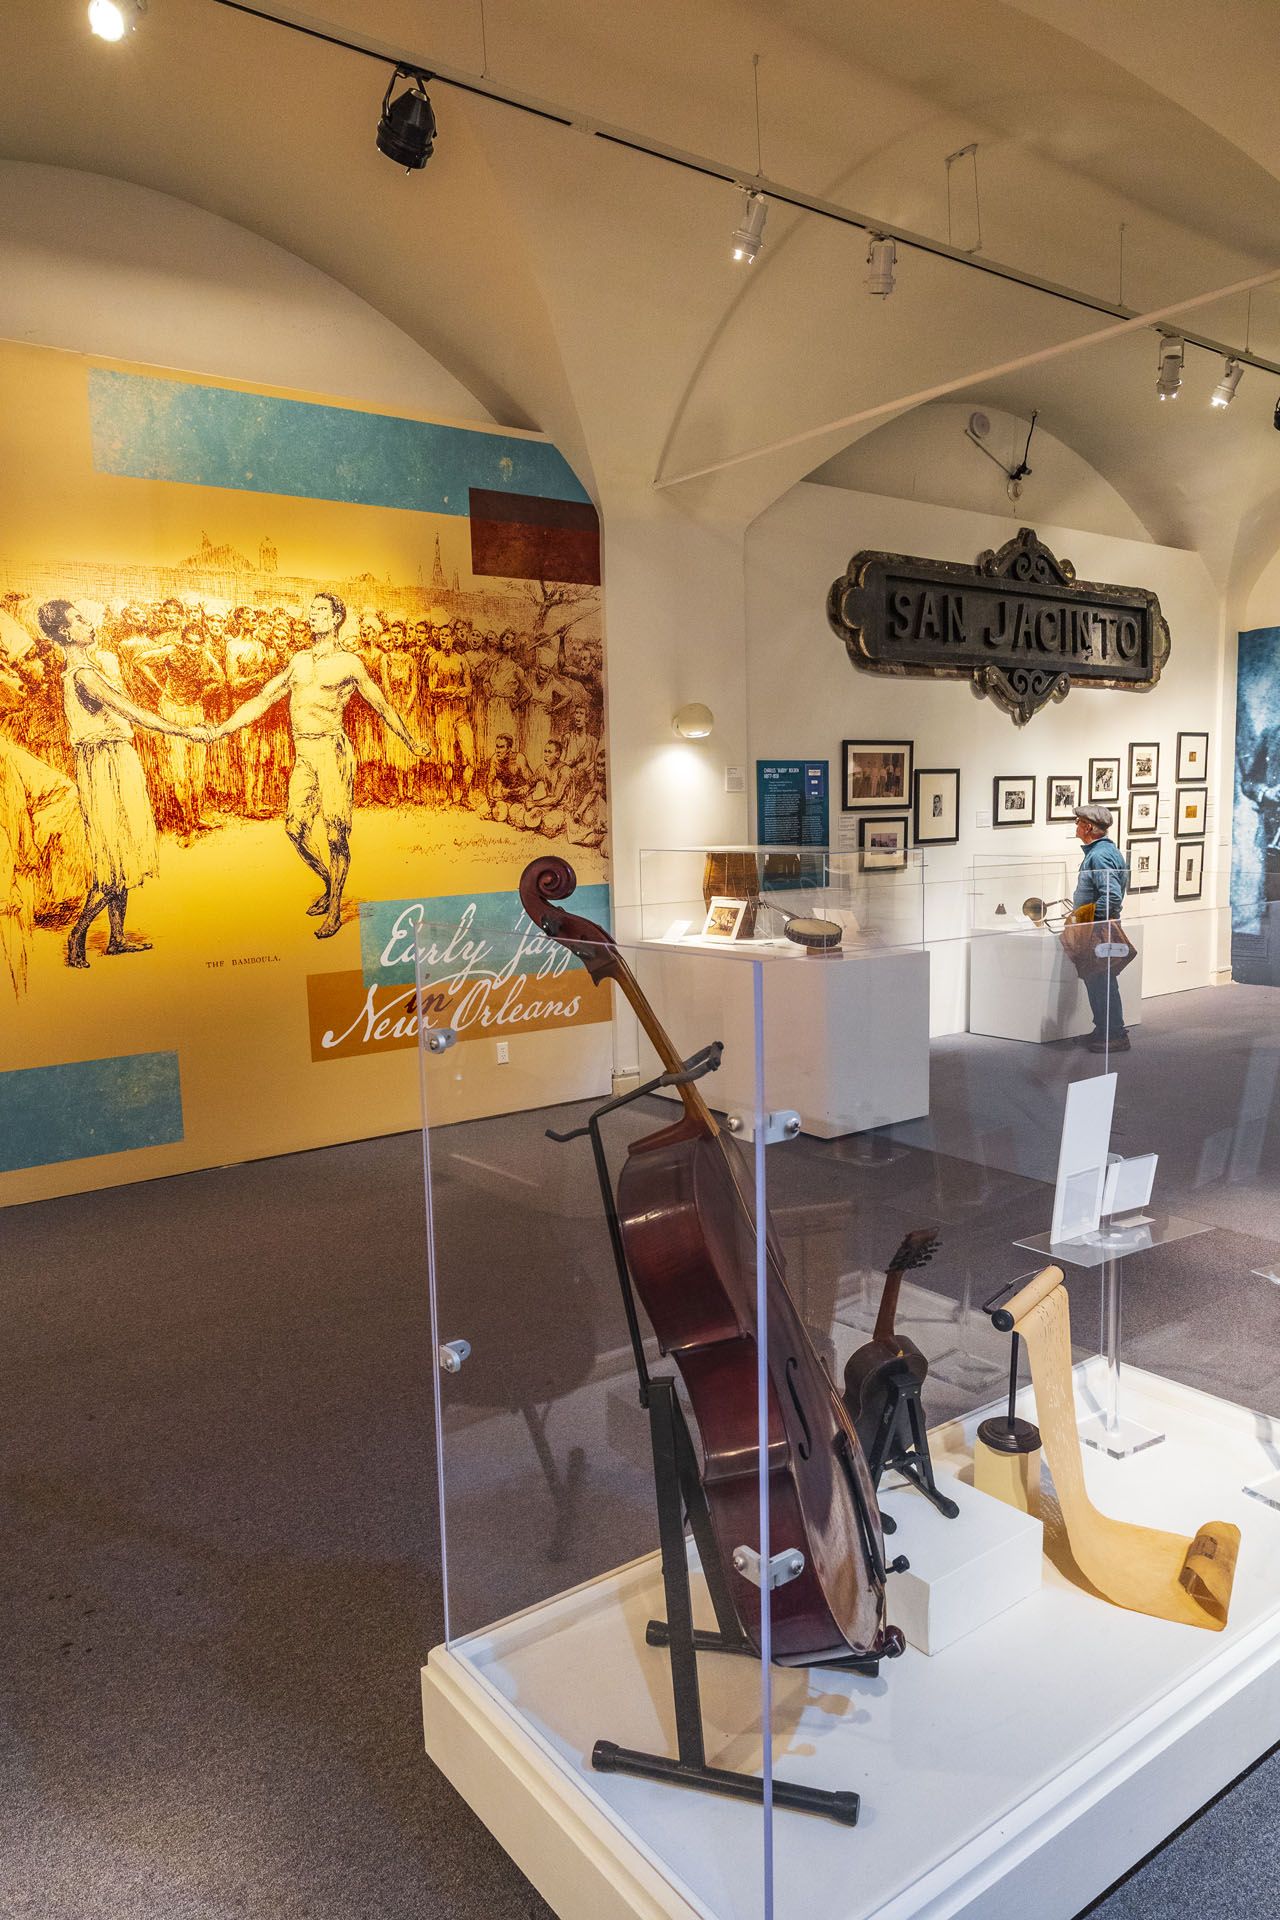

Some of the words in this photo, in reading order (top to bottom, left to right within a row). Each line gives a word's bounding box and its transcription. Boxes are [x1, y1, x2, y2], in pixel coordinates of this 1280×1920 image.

[889, 591, 966, 643] SAN
[984, 600, 1139, 660] JACINTO
[205, 960, 225, 968] THE
[380, 903, 492, 995] Early
[321, 984, 439, 1048] New
[450, 974, 582, 1032] Orleans
[404, 975, 453, 1015] in
